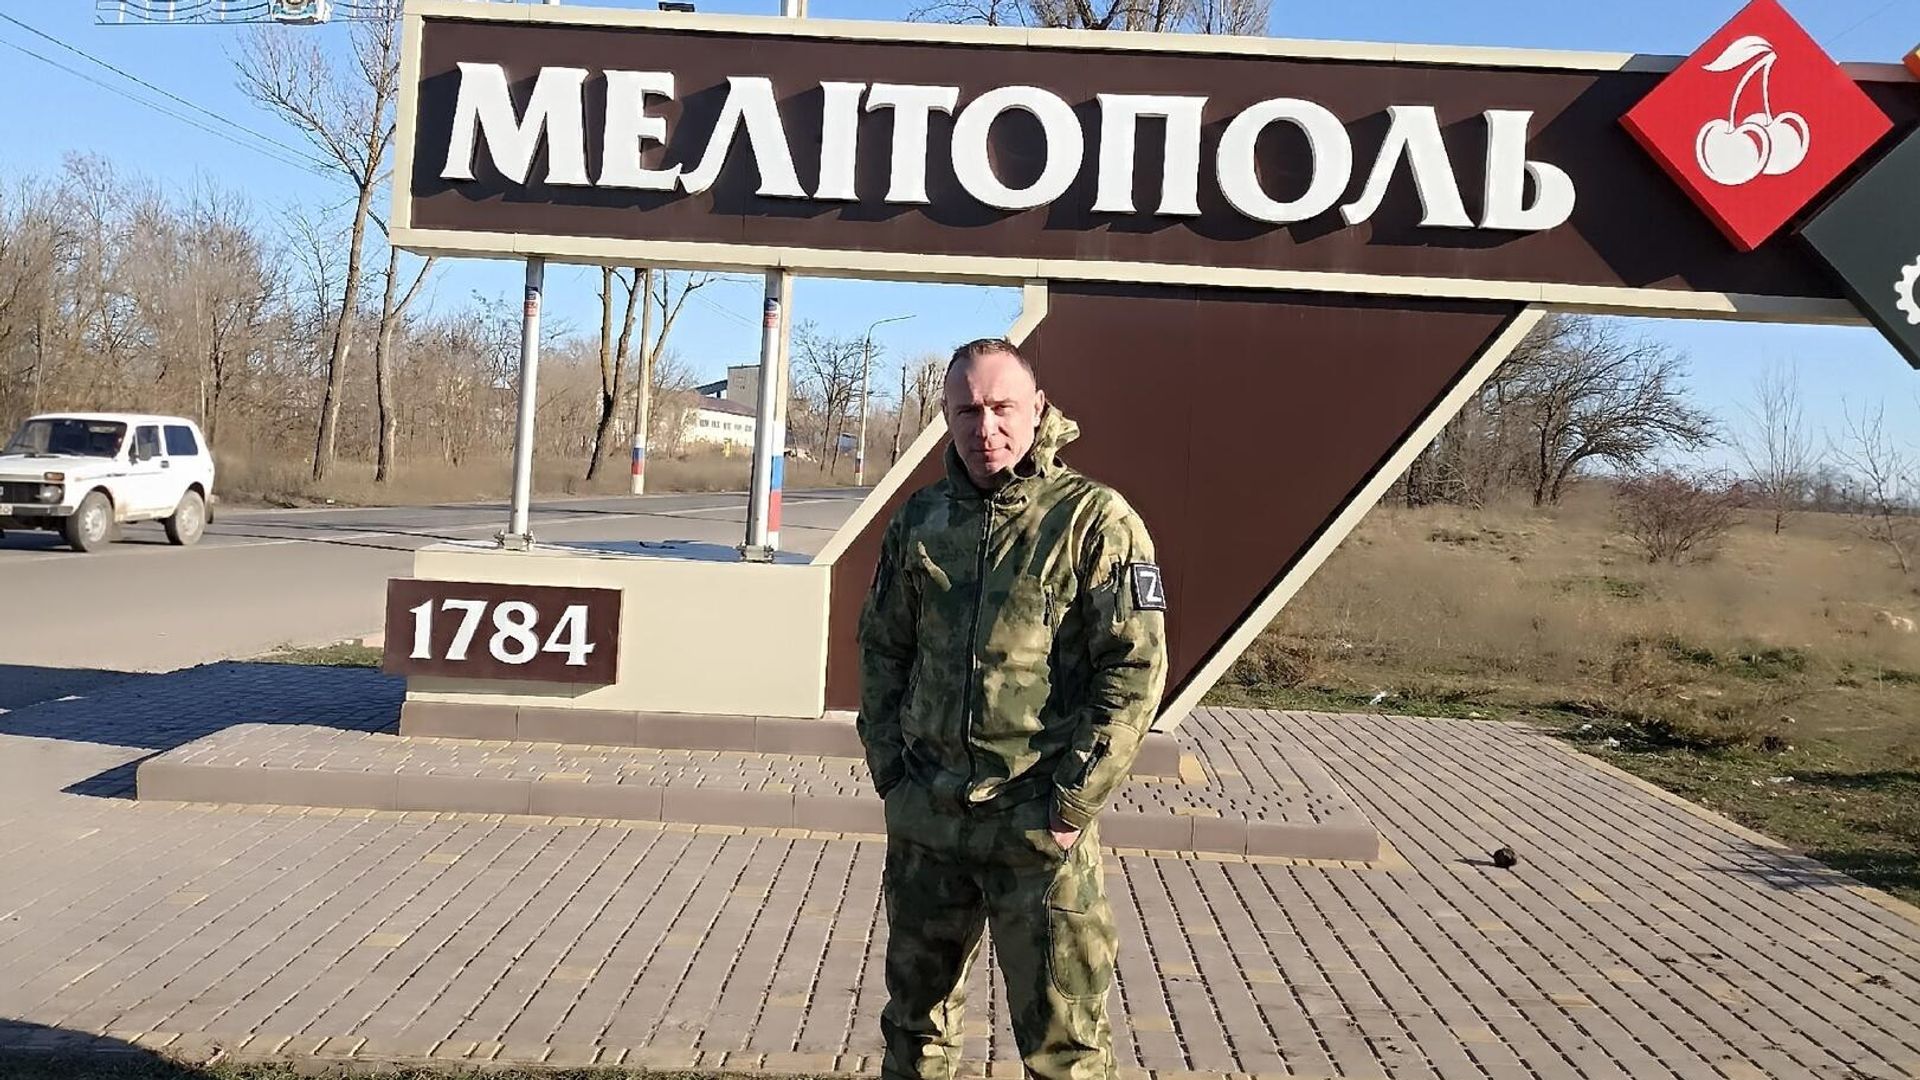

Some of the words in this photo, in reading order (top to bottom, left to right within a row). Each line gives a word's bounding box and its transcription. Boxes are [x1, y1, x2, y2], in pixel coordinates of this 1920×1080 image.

[440, 62, 1575, 231] МЕЛІТОПОЛЬ
[1139, 570, 1162, 602] Z
[409, 598, 596, 666] 1784
